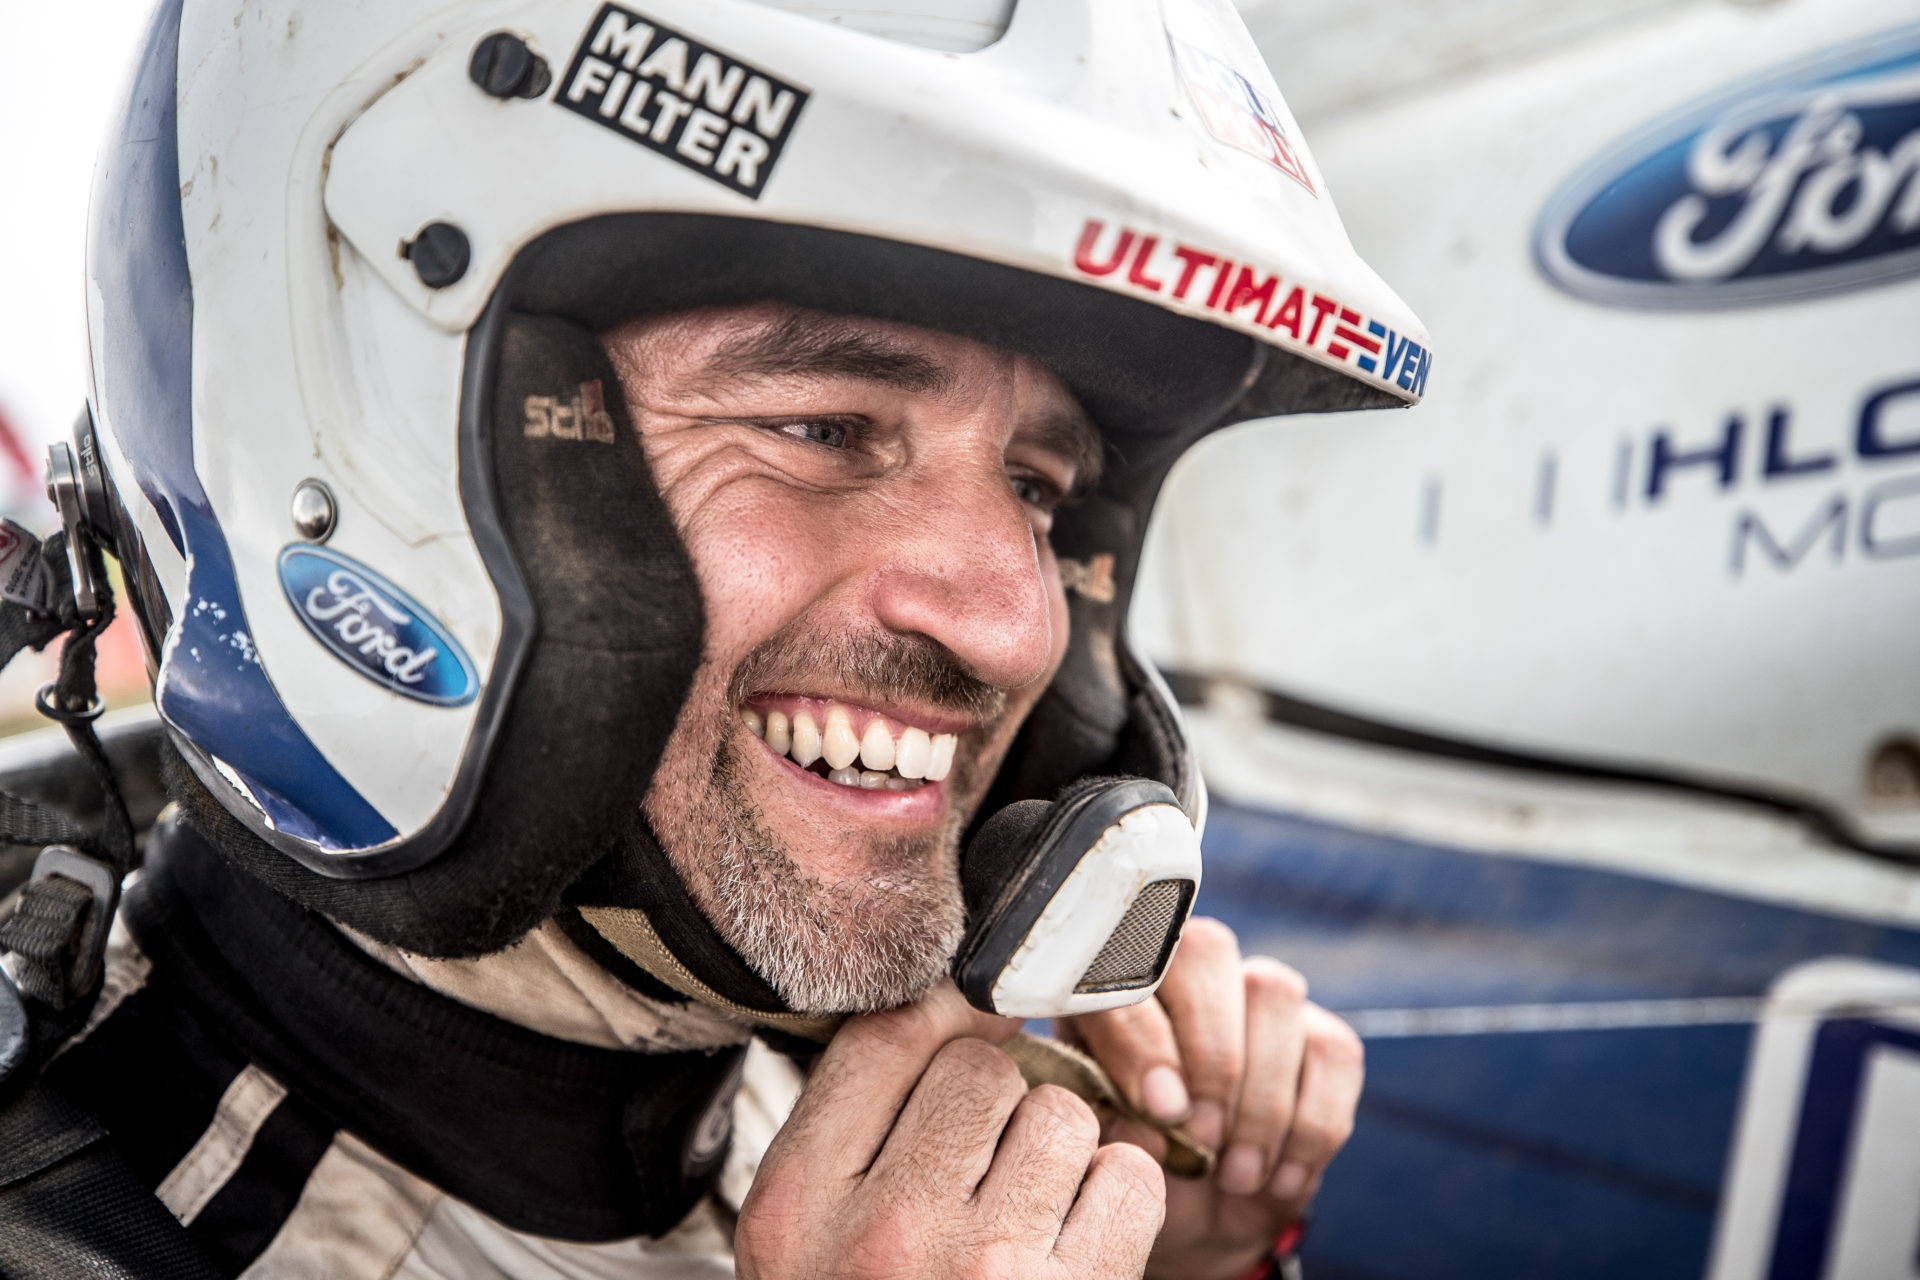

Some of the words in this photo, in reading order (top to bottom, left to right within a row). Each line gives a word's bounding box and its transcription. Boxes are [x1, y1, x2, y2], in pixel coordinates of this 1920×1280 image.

[567, 56, 769, 187] FILTER
[591, 10, 796, 139] MANN
[305, 569, 438, 683] Ford
